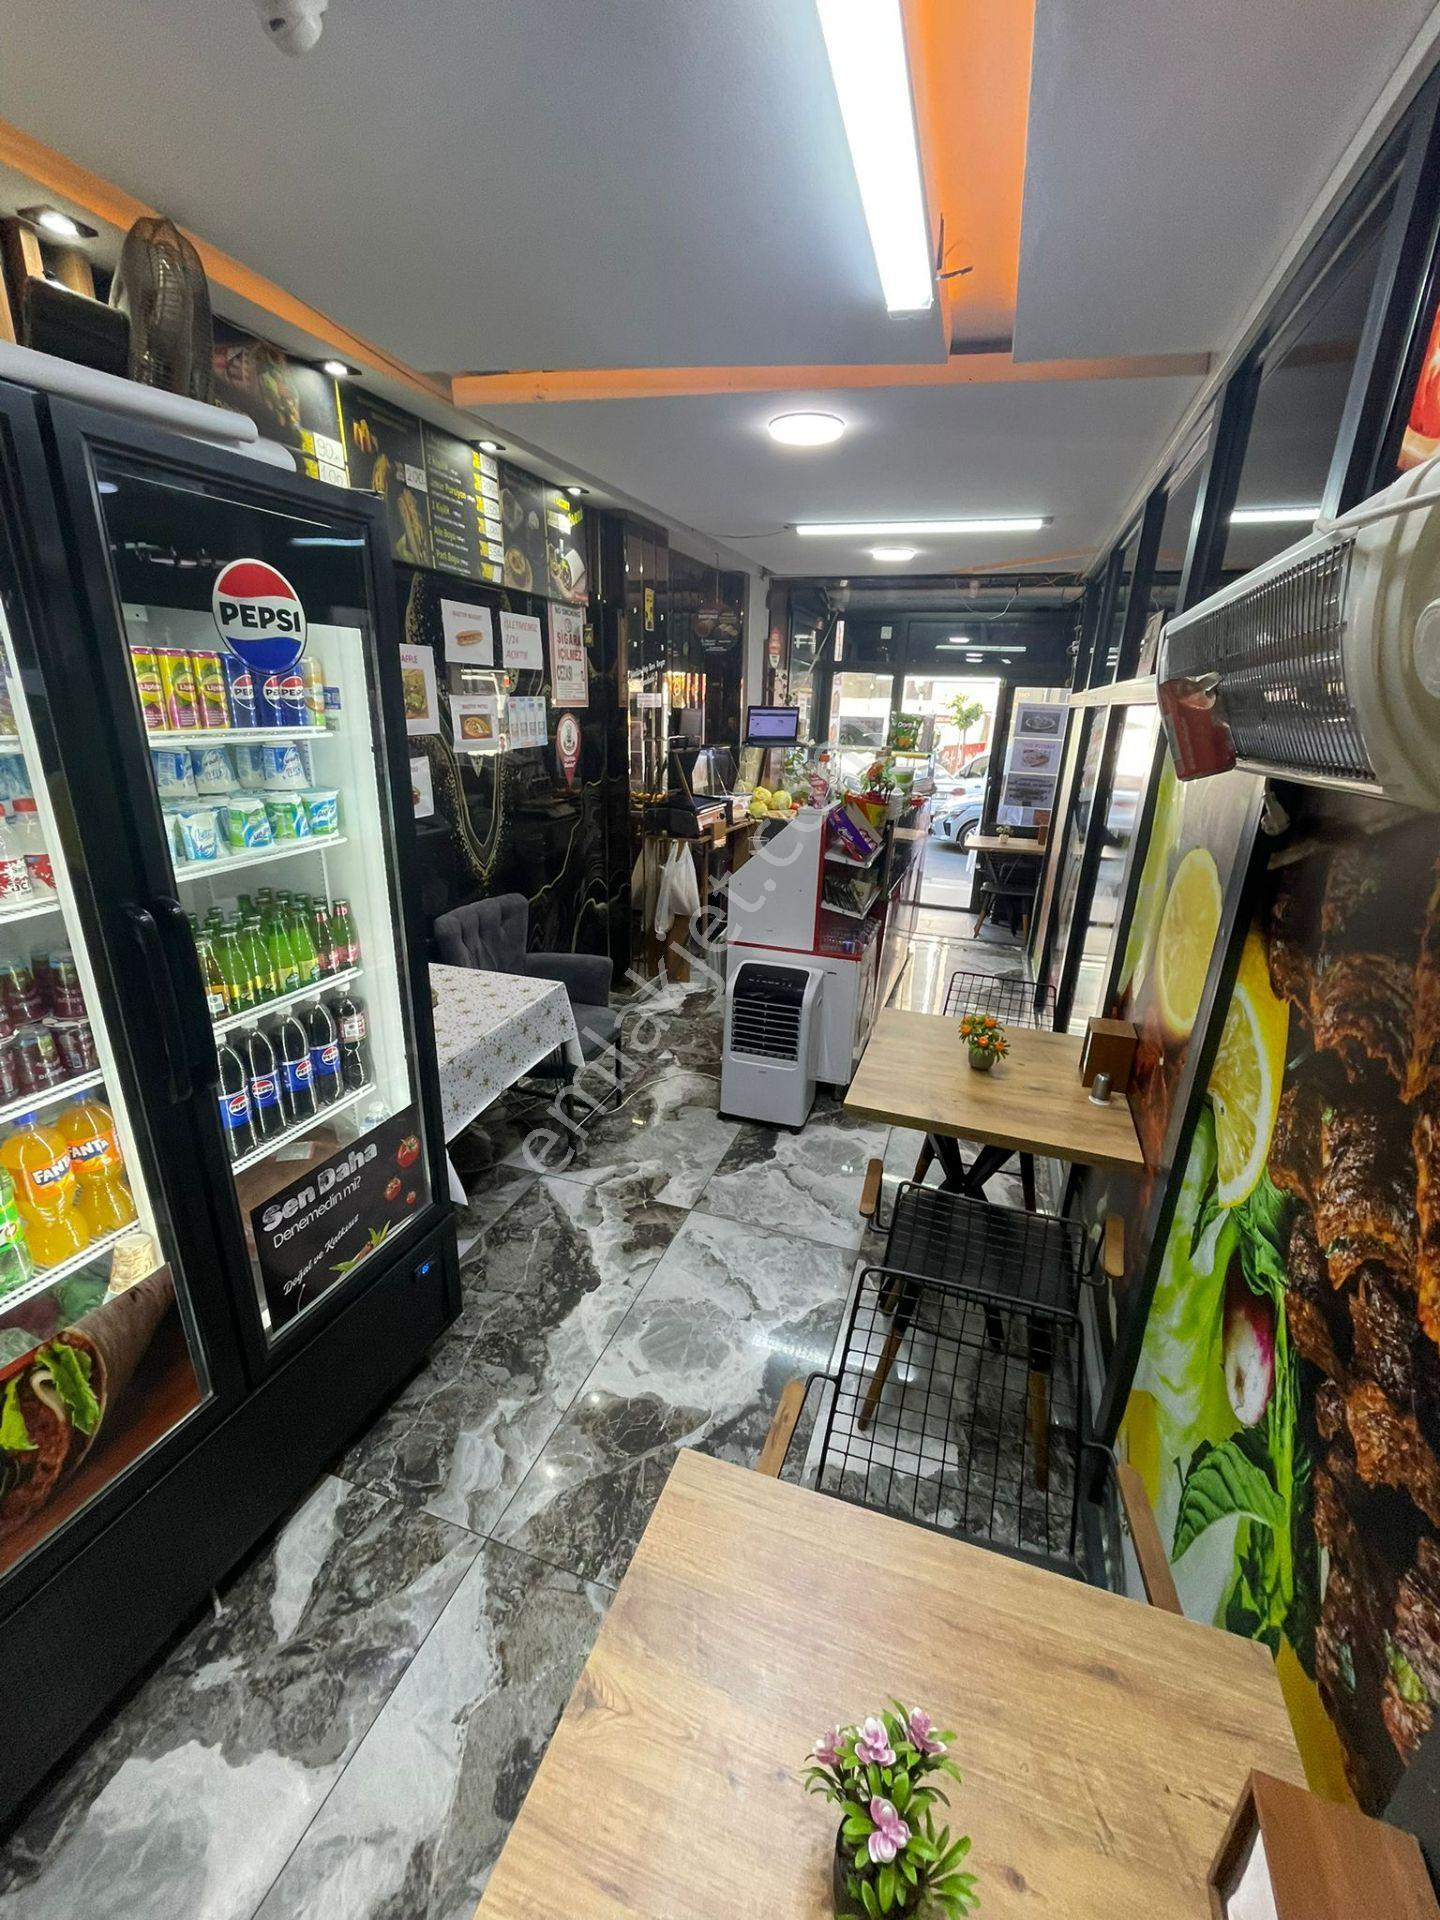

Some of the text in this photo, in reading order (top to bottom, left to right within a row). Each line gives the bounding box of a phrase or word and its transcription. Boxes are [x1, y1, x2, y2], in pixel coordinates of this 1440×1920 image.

[219, 601, 301, 633] PEPSI
[262, 1143, 378, 1232] Sen Daha
[273, 1176, 362, 1249] Denemedin mi?
[283, 1261, 312, 1296] Doğal
[313, 1251, 324, 1265] ve
